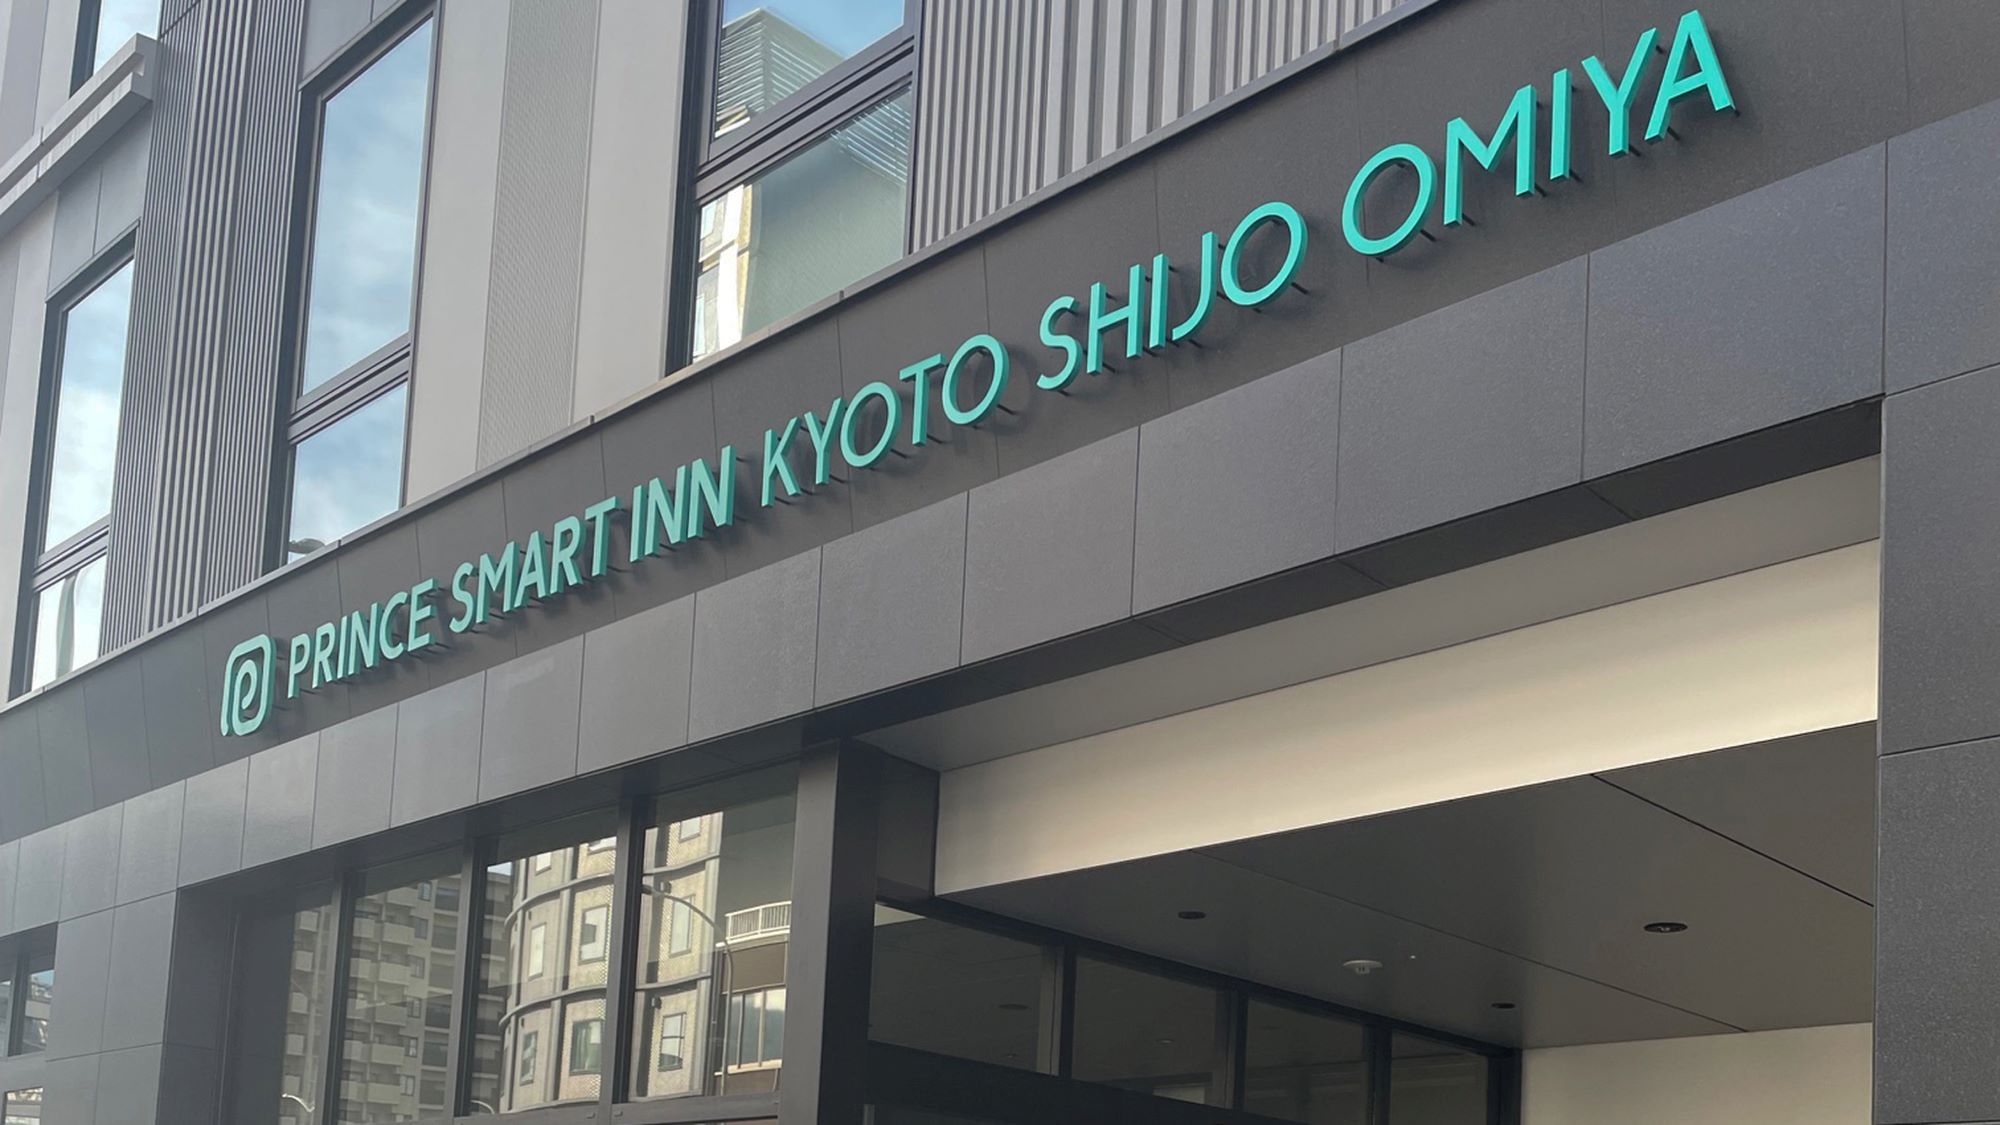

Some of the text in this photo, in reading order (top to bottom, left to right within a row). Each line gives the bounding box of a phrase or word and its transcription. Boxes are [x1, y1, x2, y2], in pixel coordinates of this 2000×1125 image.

[288, 9, 1736, 699] PRINCE SMART INN KYOTO SHIJO OMIYA
